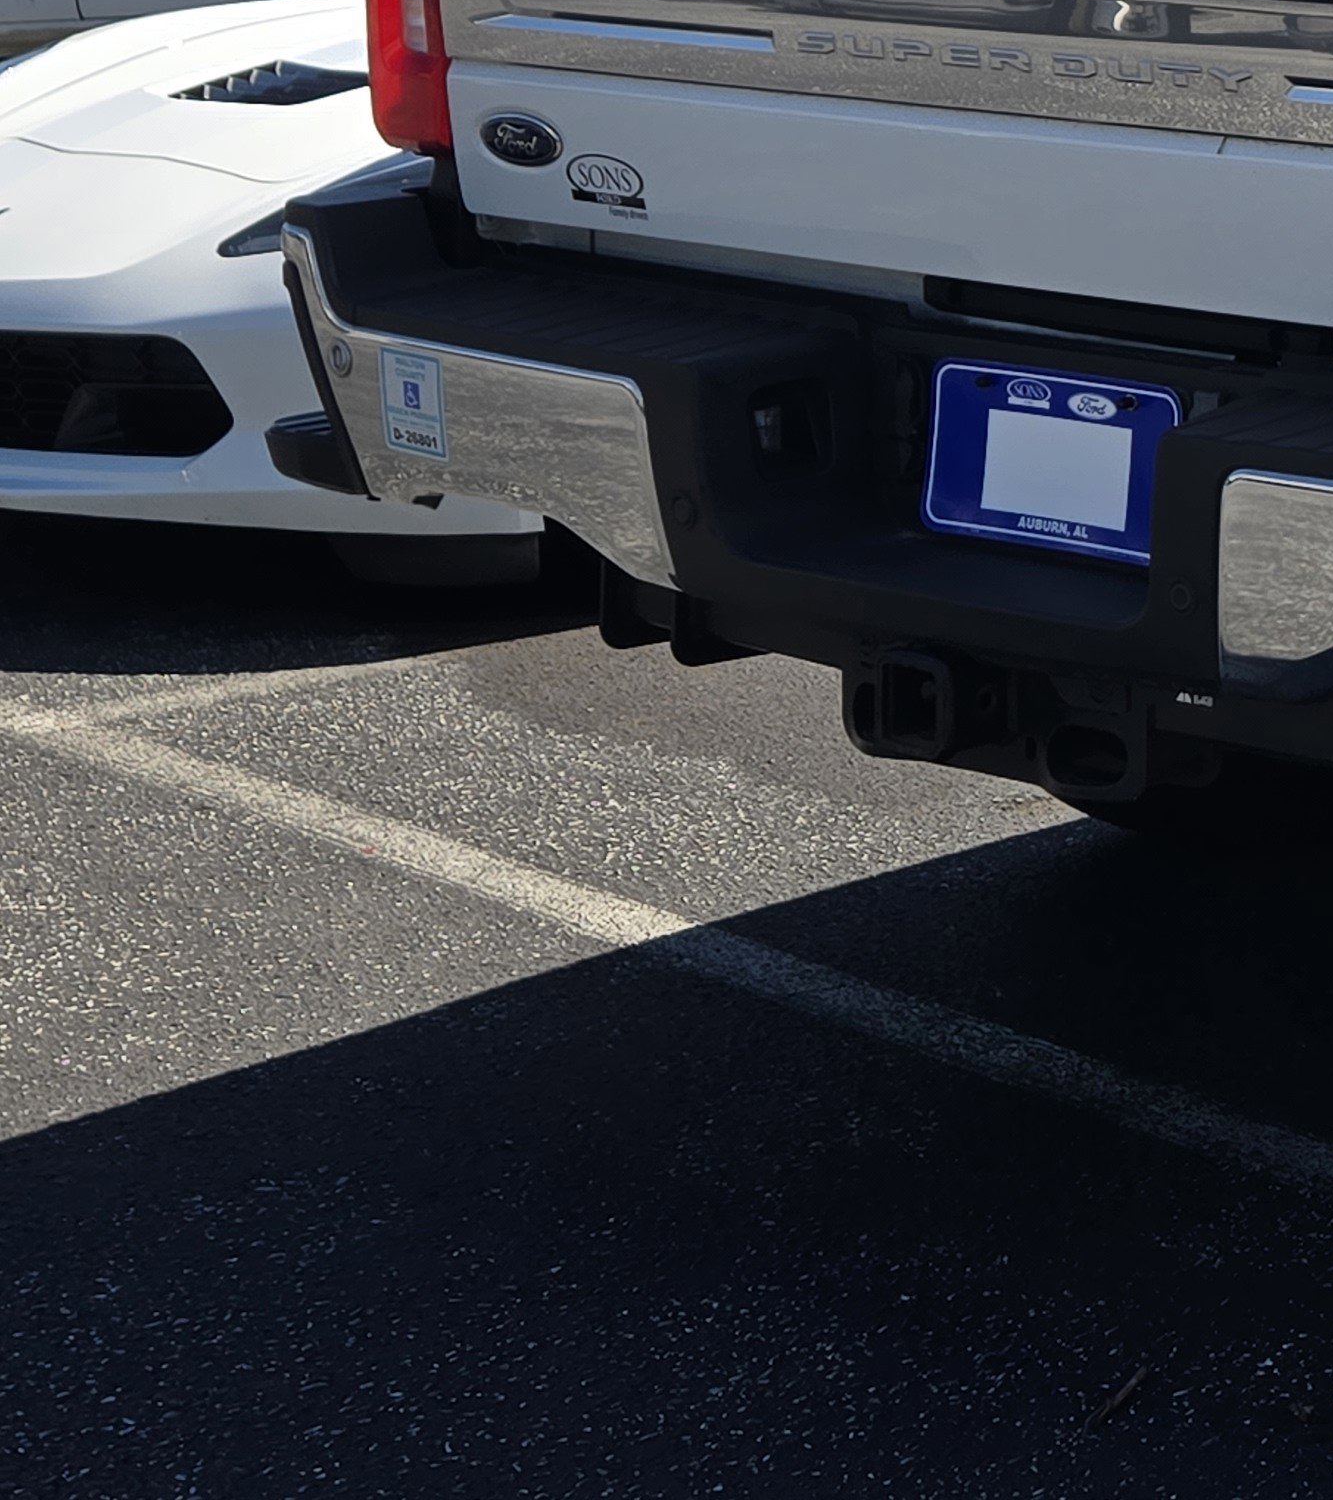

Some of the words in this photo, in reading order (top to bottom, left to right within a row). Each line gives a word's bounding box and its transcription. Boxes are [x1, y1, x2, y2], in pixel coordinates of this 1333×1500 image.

[797, 30, 1032, 73] SUPER
[1052, 52, 1254, 93] DUTY
[493, 123, 538, 156] Ford
[577, 162, 633, 193] SONS
[1076, 395, 1108, 416] Ford
[1018, 515, 1071, 537] AUBURN,
[1072, 525, 1089, 539] AL
